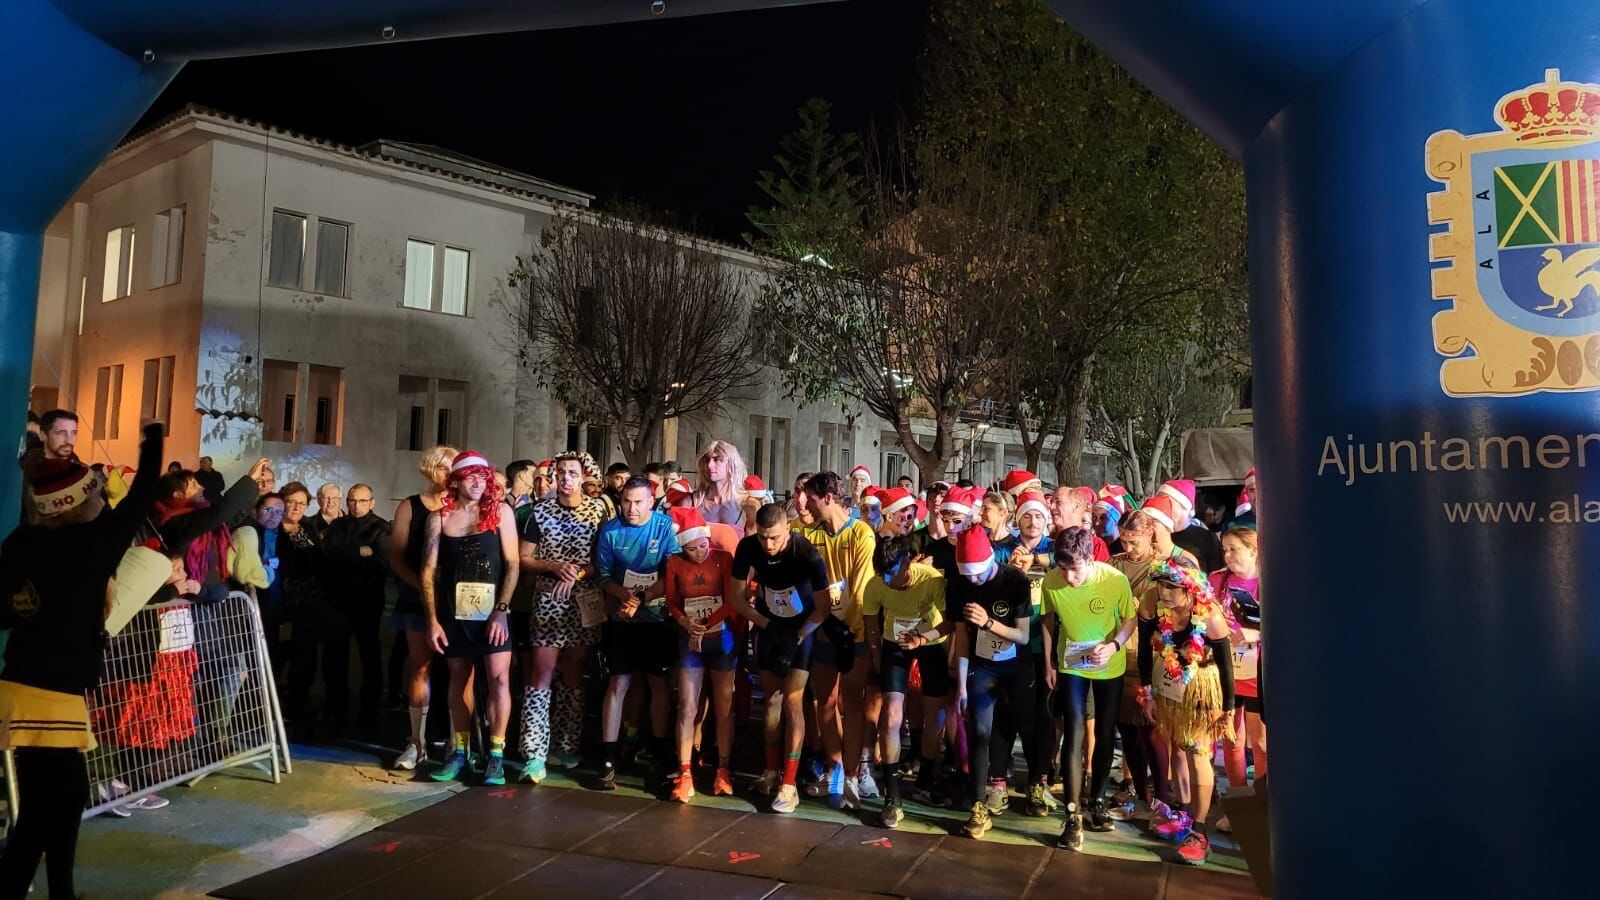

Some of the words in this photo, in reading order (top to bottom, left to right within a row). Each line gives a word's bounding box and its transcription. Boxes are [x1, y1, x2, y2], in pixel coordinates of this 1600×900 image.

[52, 495, 75, 508] HO
[470, 595, 480, 604] 74
[696, 607, 713, 618] 113
[991, 640, 1003, 649] 37
